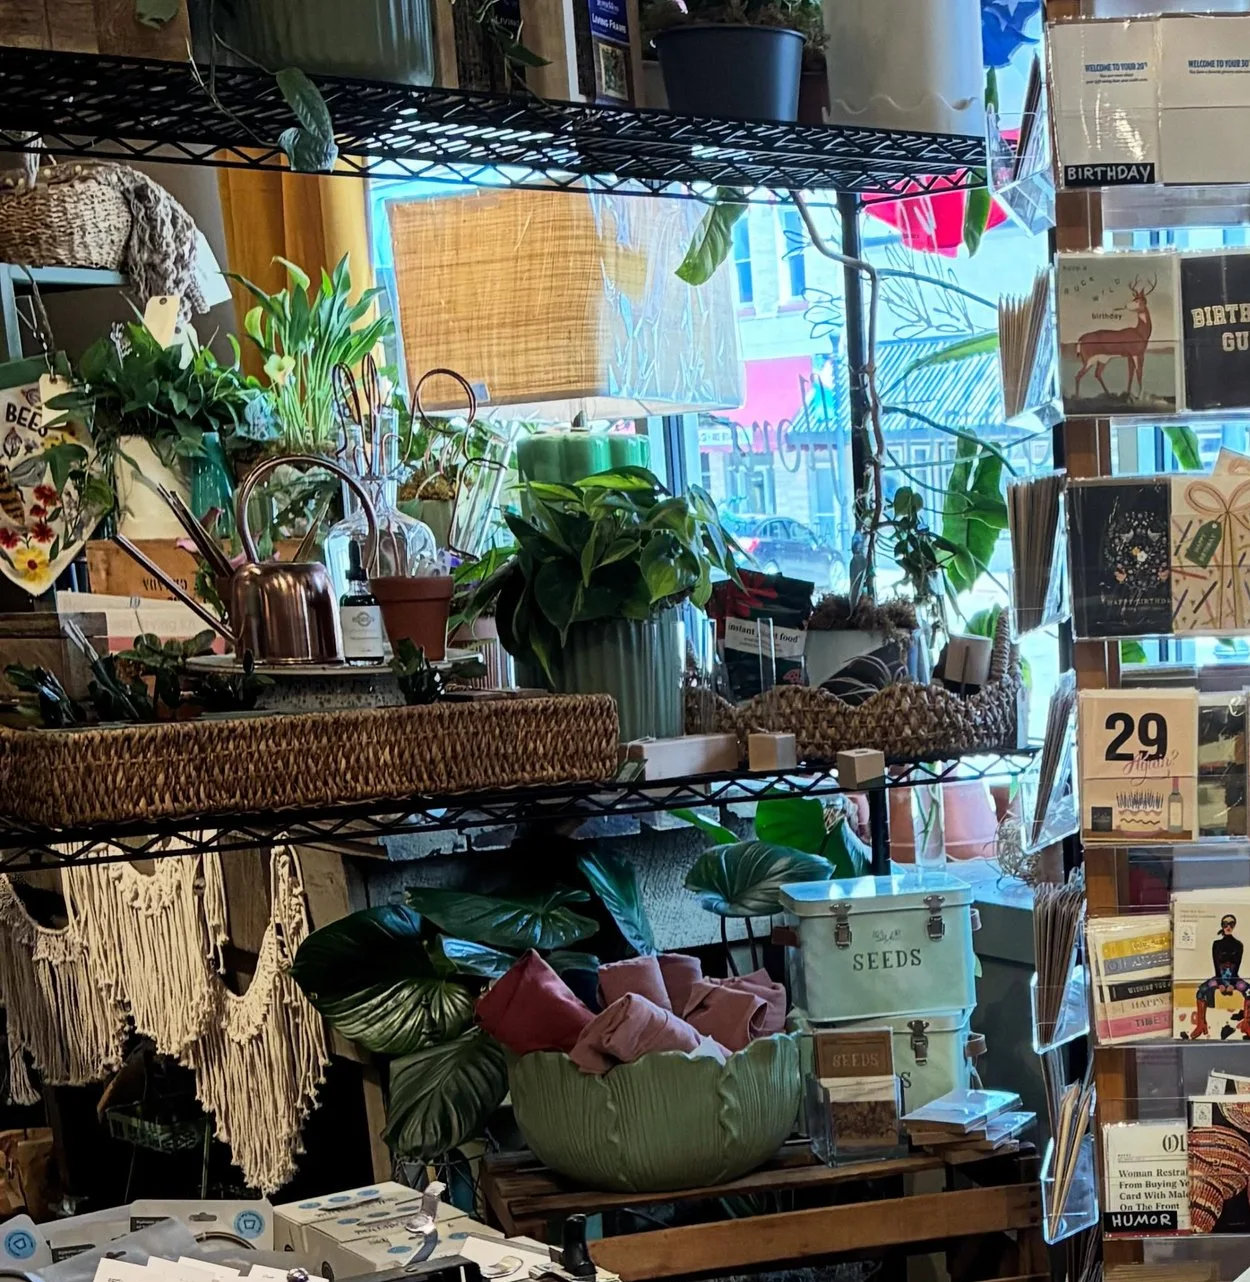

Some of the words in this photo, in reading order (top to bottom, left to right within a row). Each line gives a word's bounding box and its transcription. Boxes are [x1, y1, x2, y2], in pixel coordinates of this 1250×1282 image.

[1067, 165, 1150, 182] BIRTHDAY
[1091, 311, 1123, 321] birthday
[728, 624, 755, 635] instant
[779, 633, 799, 643] food
[1104, 712, 1168, 762] 29
[853, 949, 922, 971] SEEDS
[1131, 998, 1164, 1009] HAPPY
[1135, 1016, 1161, 1027] TIME
[832, 1053, 880, 1068] SEEDS
[1119, 1169, 1154, 1178] Woman
[1119, 1181, 1143, 1190] From
[1145, 1180, 1177, 1190] Buying
[1119, 1191, 1141, 1200] Card
[1144, 1190, 1166, 1200] With
[1119, 1203, 1133, 1212] On
[1136, 1202, 1153, 1211] The
[1156, 1202, 1180, 1210] Front
[1112, 1214, 1172, 1228] HUMOR
